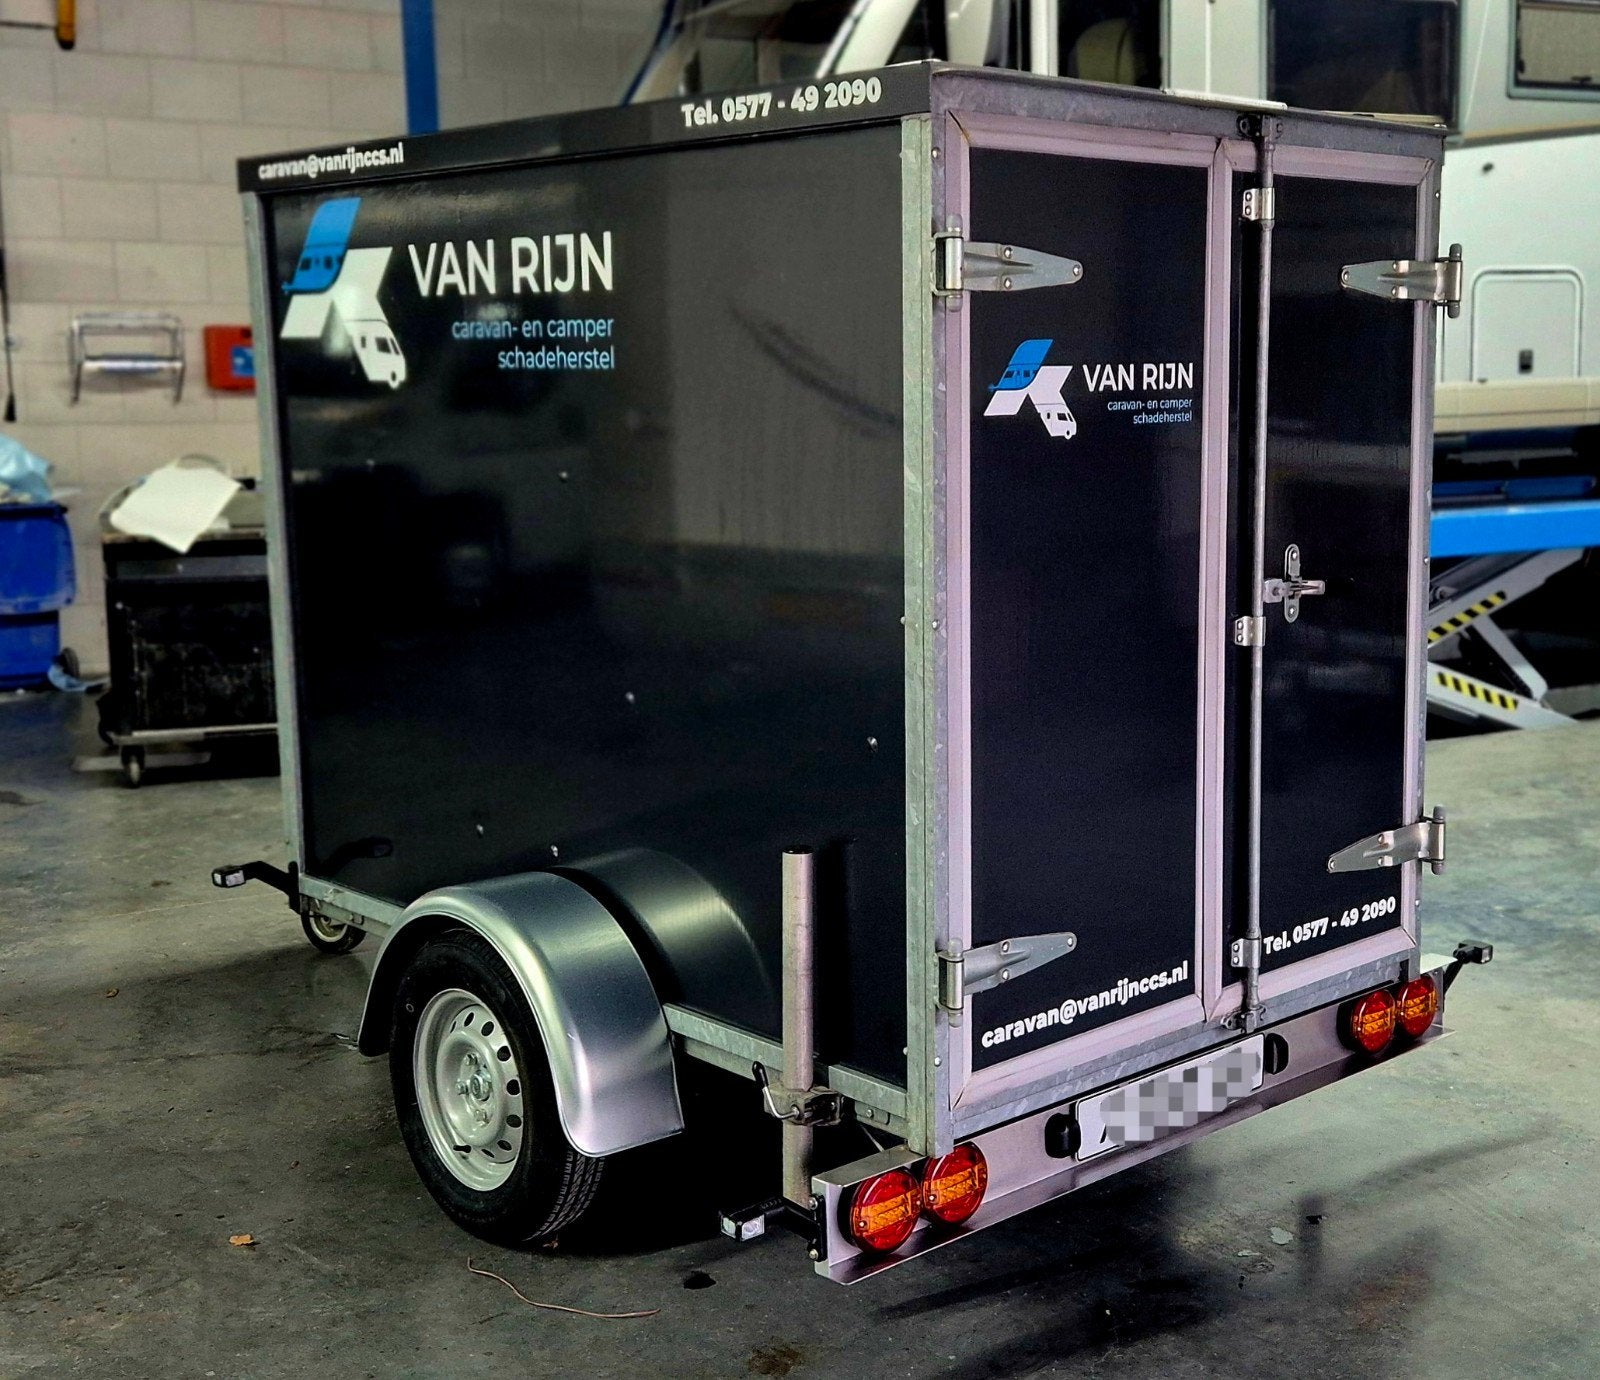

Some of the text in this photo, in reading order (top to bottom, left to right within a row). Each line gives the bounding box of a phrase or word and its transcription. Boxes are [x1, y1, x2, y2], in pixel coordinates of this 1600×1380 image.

[681, 100, 718, 127] Tel.
[722, 93, 772, 122] 0577
[791, 86, 820, 113] 49
[824, 76, 882, 108] 2090
[258, 142, 404, 178] caravan@vanrijnccs.nl
[409, 231, 614, 297] VAN RIJN
[452, 315, 614, 342] caravan- en camper
[498, 345, 615, 371] schadeherstel
[1082, 362, 1194, 392] VAN RIJN
[1107, 398, 1193, 411] caravan- en camper
[1133, 411, 1192, 424] schadeherstel
[1263, 932, 1291, 955] Tel.
[1292, 922, 1328, 947] 0577
[1340, 909, 1360, 929] 49
[1361, 896, 1397, 924] 2090
[981, 960, 1188, 1049] caravan@vanrijnccs.nl
